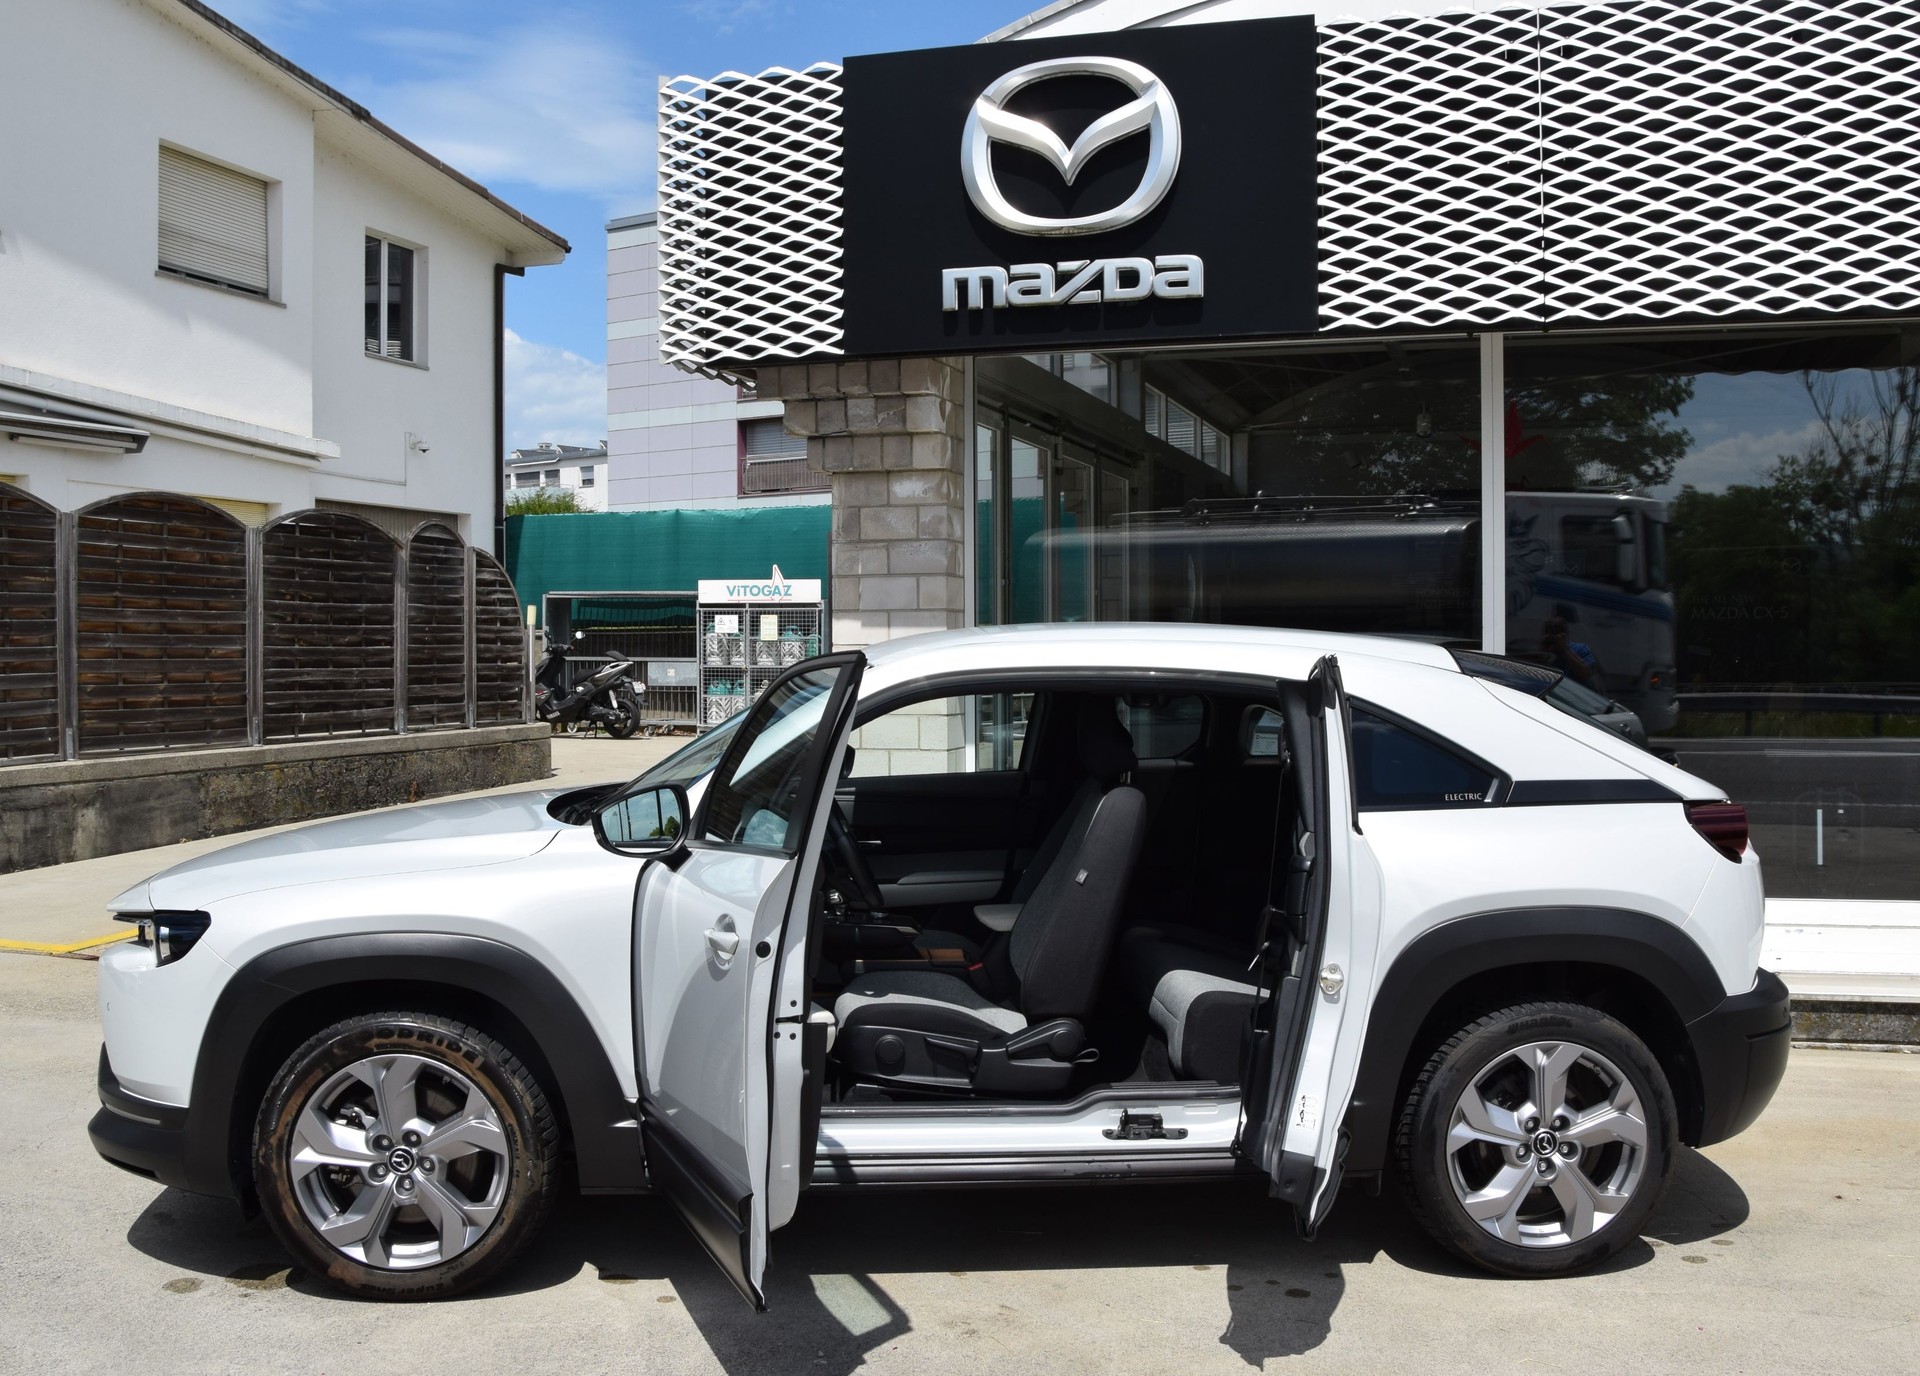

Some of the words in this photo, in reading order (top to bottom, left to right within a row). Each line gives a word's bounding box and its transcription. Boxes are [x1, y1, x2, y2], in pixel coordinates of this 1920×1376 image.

[942, 254, 1204, 312] mazda
[1691, 606, 1750, 620] MAZDA
[1753, 605, 1789, 620] CX-5
[1444, 792, 1483, 801] ELECTRIC
